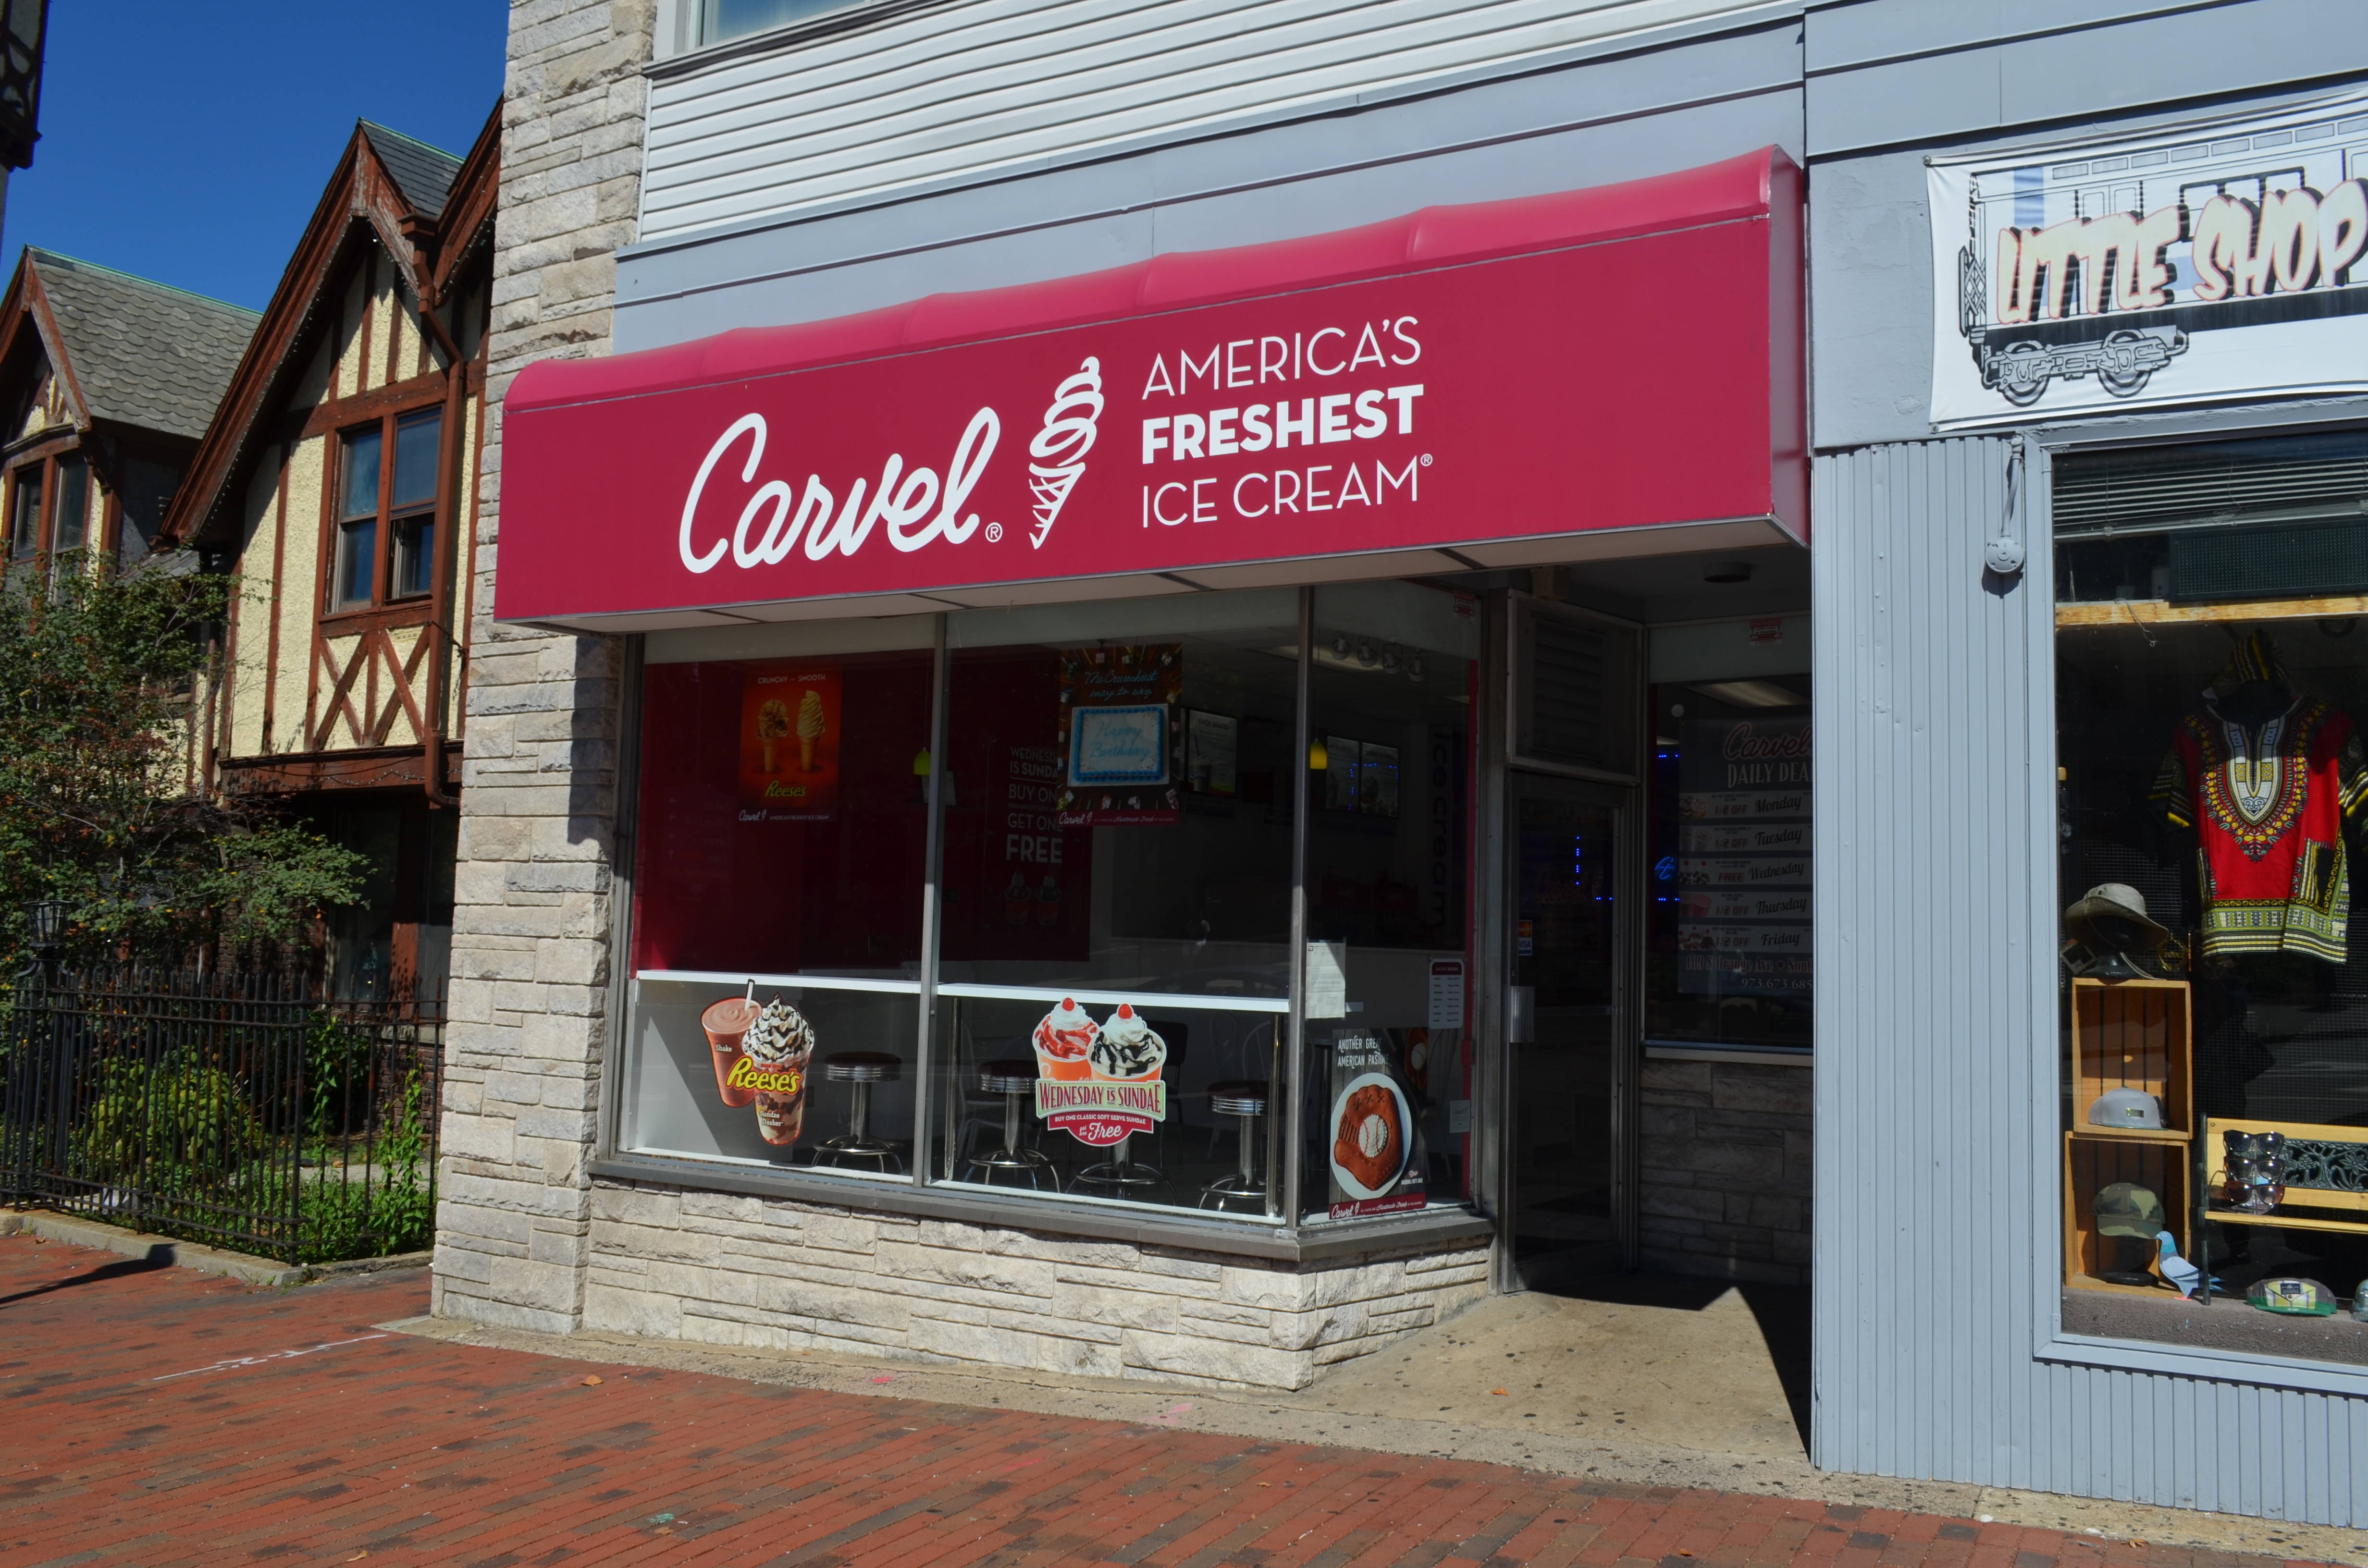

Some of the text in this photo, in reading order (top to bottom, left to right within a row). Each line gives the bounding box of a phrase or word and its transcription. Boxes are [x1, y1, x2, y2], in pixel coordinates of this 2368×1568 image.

[1997, 179, 2368, 325] LITTLE SHOP
[1142, 316, 1421, 400] AMERICA'S
[1143, 384, 1424, 464] FRESHEST
[1143, 478, 1217, 528] ICE
[757, 676, 788, 684] CRUNCHY
[798, 674, 826, 682] SMOOTH
[1096, 720, 1142, 743] Happy
[1089, 740, 1150, 762] Birthday
[1010, 761, 1019, 774] IS
[1727, 761, 1813, 788] DAILY DEA
[765, 779, 807, 798] Reese's
[1009, 784, 1035, 801] BUY
[1754, 796, 1802, 814] Monday
[1008, 813, 1034, 830] GET
[1059, 811, 1085, 825] Carvel
[1755, 828, 1802, 846] Tuesday
[1006, 833, 1063, 864] FREE
[1718, 872, 1745, 882] FREE
[1749, 862, 1804, 881] Wednesday
[1756, 897, 1807, 915] Thursday
[1761, 933, 1800, 946] Friday
[715, 1044, 733, 1053] Shake
[1338, 1035, 1362, 1053] ANOTHER
[1337, 1054, 1365, 1069] AMERICAN
[726, 1056, 801, 1093] Reese's
[1039, 1082, 1161, 1114] WEDNESDAY IS SUNDAE
[760, 1110, 780, 1118] Sundae
[1126, 1116, 1146, 1125] SUNDAE
[1087, 1122, 1122, 1141] Free
[1331, 1204, 1354, 1219] Carvel
